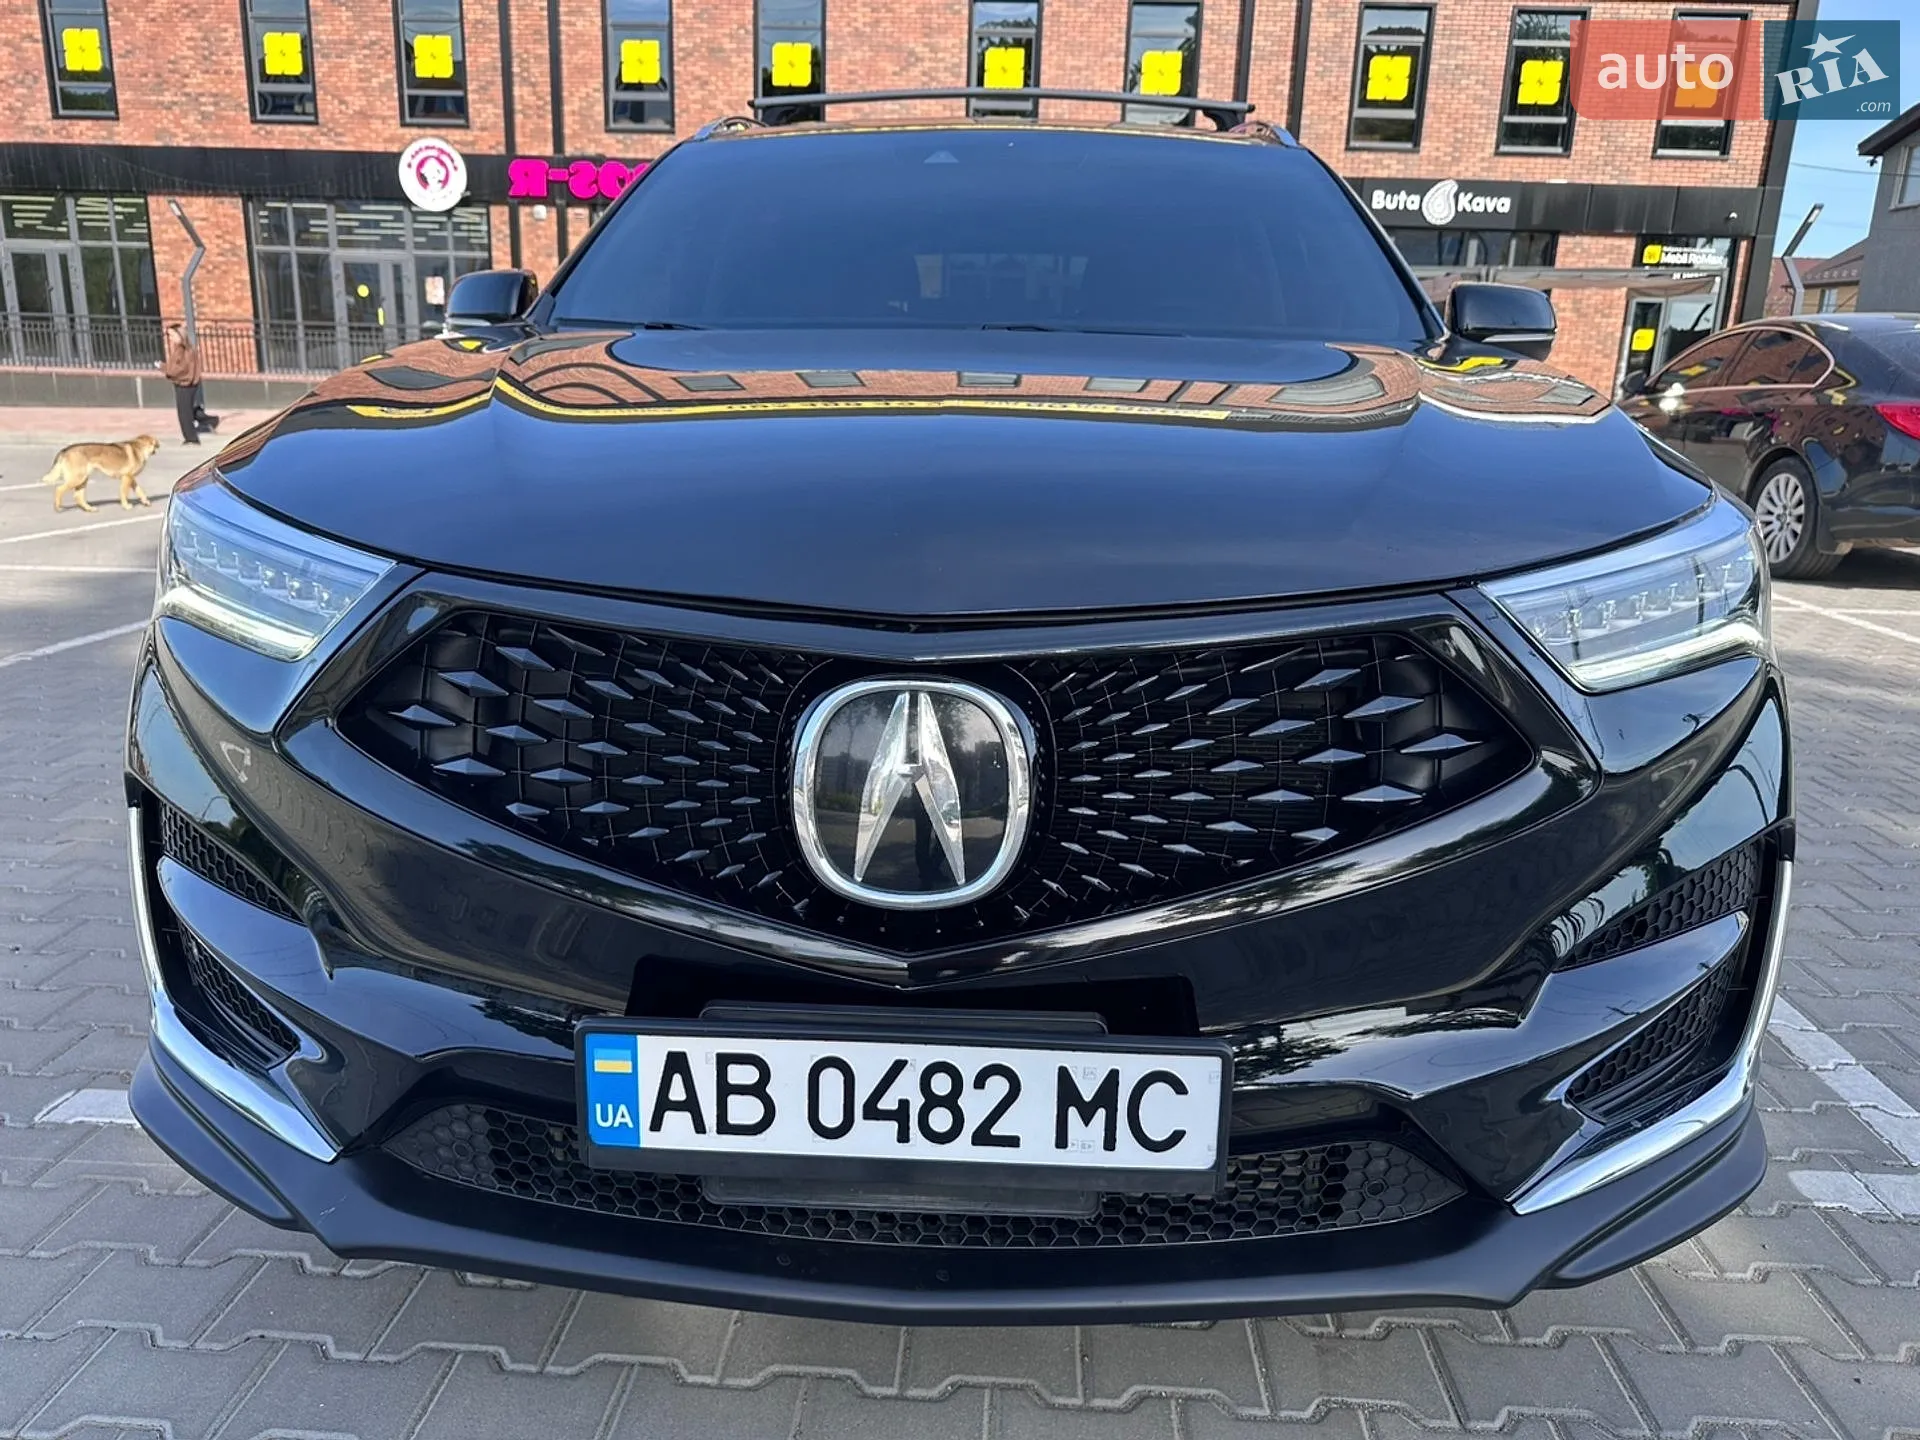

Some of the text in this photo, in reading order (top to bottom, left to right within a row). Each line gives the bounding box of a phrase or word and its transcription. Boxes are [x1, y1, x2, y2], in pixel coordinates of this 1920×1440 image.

[1372, 190, 1511, 214] Buta Kava
[649, 1050, 1190, 1153] AB 0482 MC
[594, 1103, 633, 1129] UA
